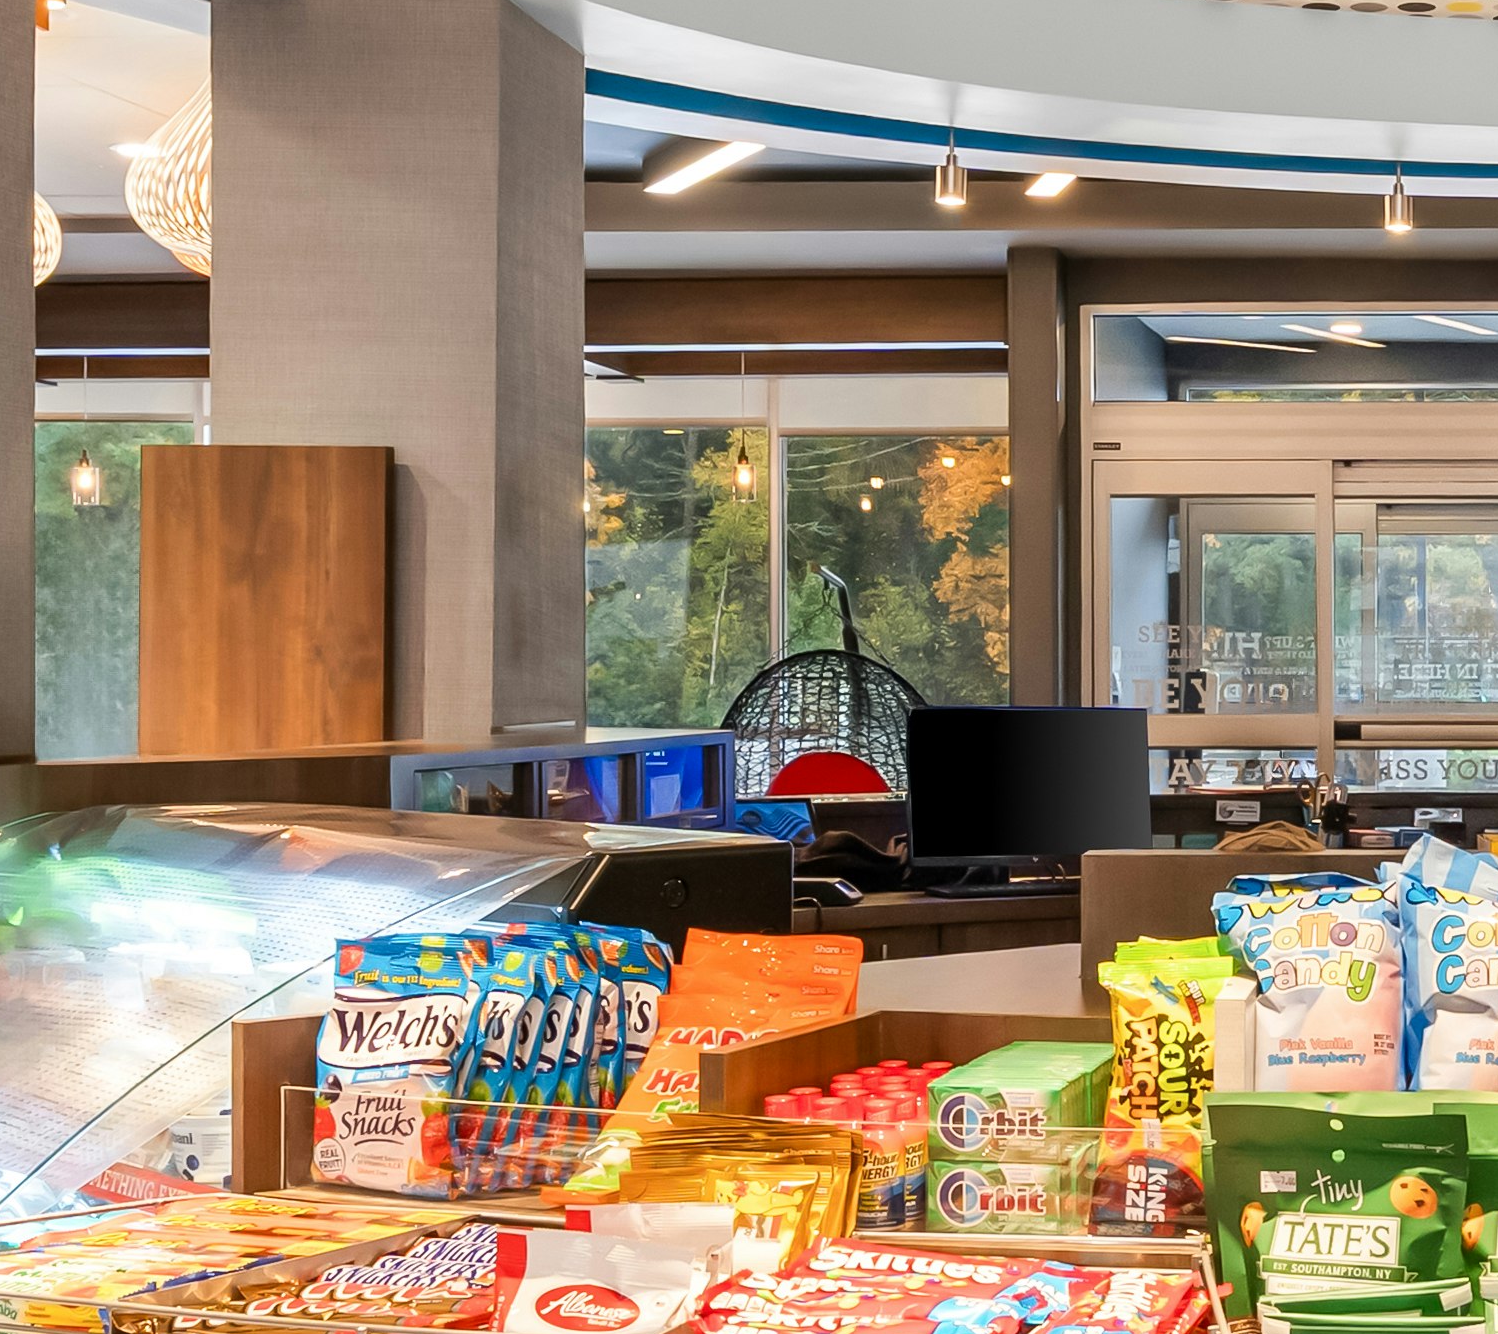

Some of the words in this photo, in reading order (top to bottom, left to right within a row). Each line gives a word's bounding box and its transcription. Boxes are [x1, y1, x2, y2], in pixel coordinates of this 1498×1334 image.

[814, 944, 840, 955] Share
[1245, 912, 1386, 959] Cotton
[354, 970, 380, 986] Fruit
[813, 964, 839, 975] Share
[1254, 951, 1377, 1003] Candy
[332, 1004, 459, 1054] Welch's
[1279, 1037, 1307, 1052] Pink
[1310, 1036, 1354, 1050] Vanilla
[1455, 1052, 1482, 1064] Blue
[1468, 1038, 1495, 1053] Pink
[1126, 1016, 1160, 1120] PATCH
[1158, 1019, 1190, 1116] SOUR
[1267, 1053, 1294, 1067] Blue
[1298, 1051, 1366, 1067] Raspberry
[353, 1089, 407, 1116] Fruit
[338, 1111, 417, 1140] Snacks
[937, 1091, 1048, 1152] Orbit
[319, 1148, 340, 1159] REAL
[936, 1167, 1048, 1227] Orbit
[1310, 1169, 1364, 1211] tiny
[1283, 1220, 1391, 1259] TATE'S
[810, 1245, 1003, 1284] Skittles
[1375, 1268, 1392, 1279] NY
